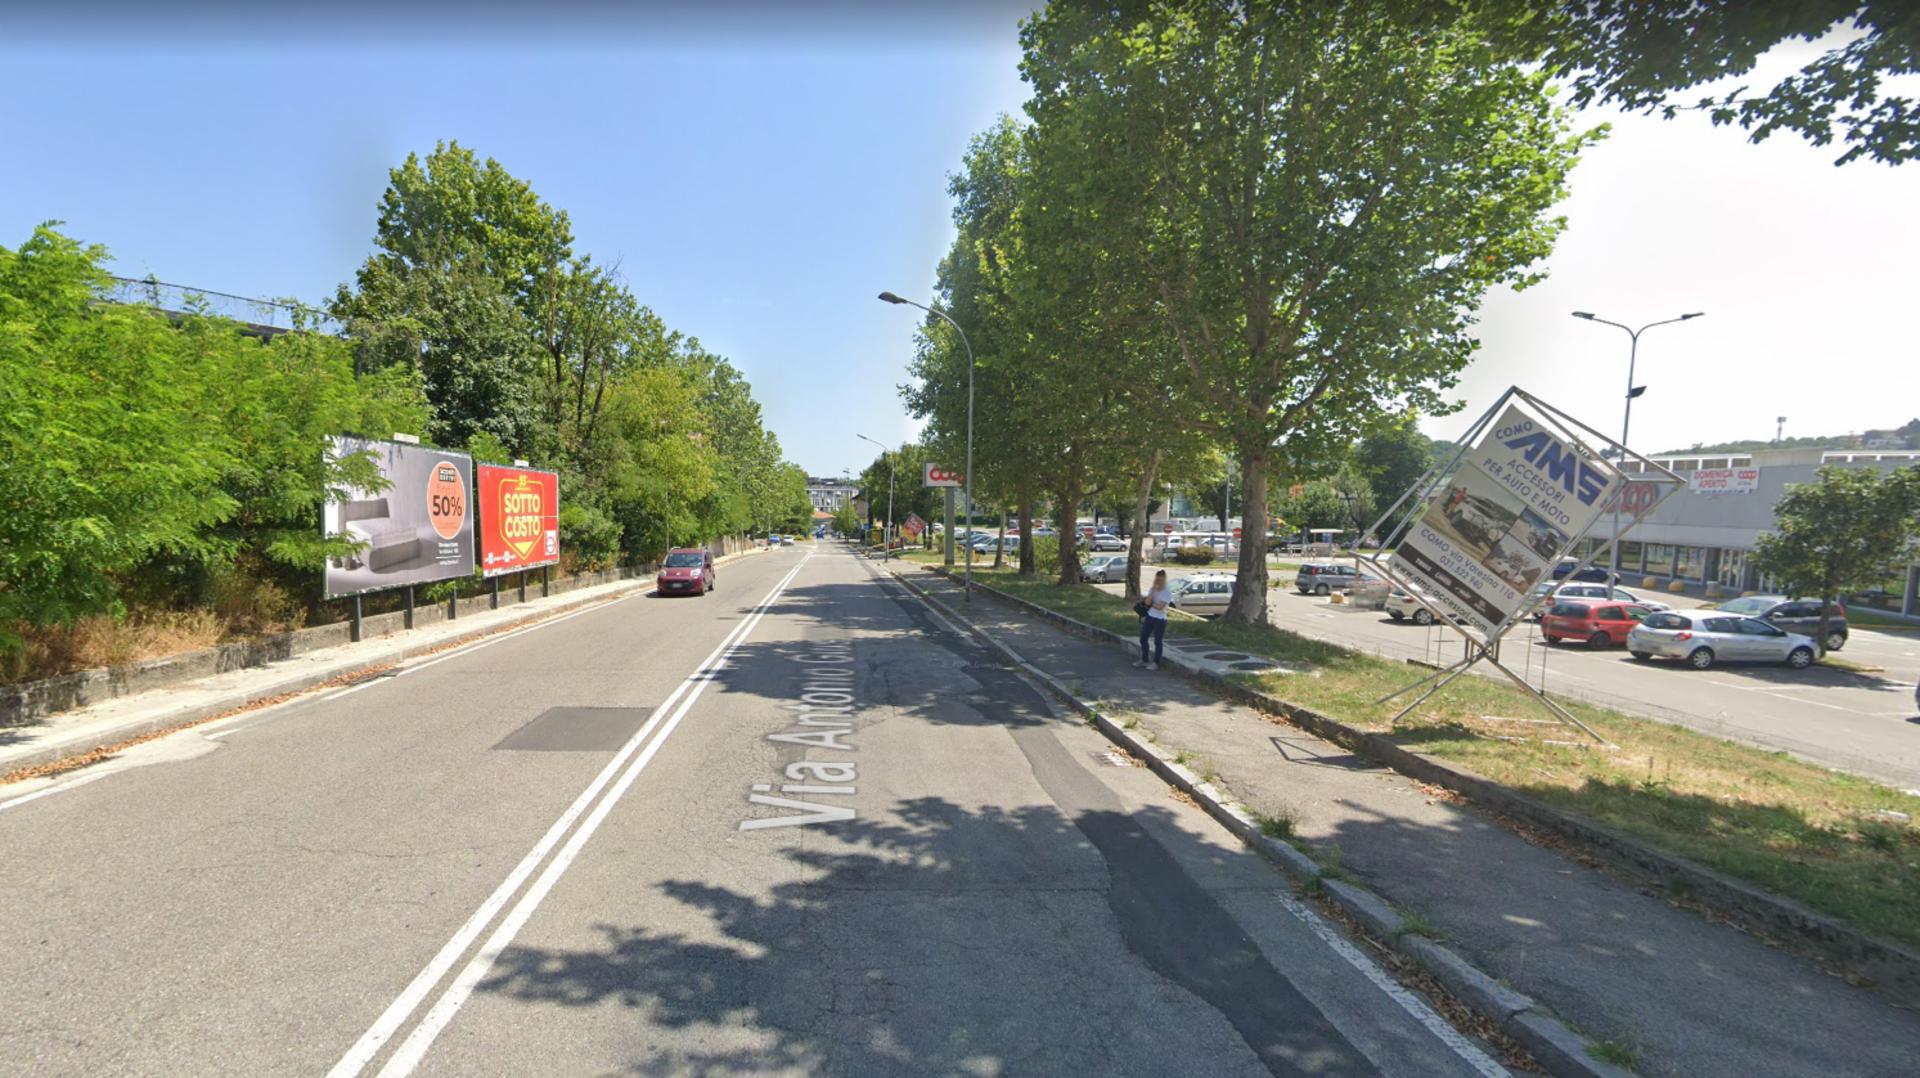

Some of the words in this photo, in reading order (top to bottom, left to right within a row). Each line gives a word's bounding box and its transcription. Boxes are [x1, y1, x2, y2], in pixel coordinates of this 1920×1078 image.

[1495, 421, 1533, 440] COMO
[1503, 431, 1610, 507] AMS
[1482, 458, 1503, 476] PER
[1503, 473, 1532, 496] AUTO
[1531, 492, 1540, 503] E
[1538, 499, 1570, 525] MOTO
[1507, 459, 1565, 504] ACCESSORI
[1699, 480, 1728, 488] APERTO
[433, 495, 463, 517] 50%
[504, 492, 541, 514] SOTTO
[504, 515, 541, 538] COSTO
[1420, 528, 1450, 552] COMO
[1449, 550, 1464, 562] via
[1465, 559, 1498, 588] Varesina
